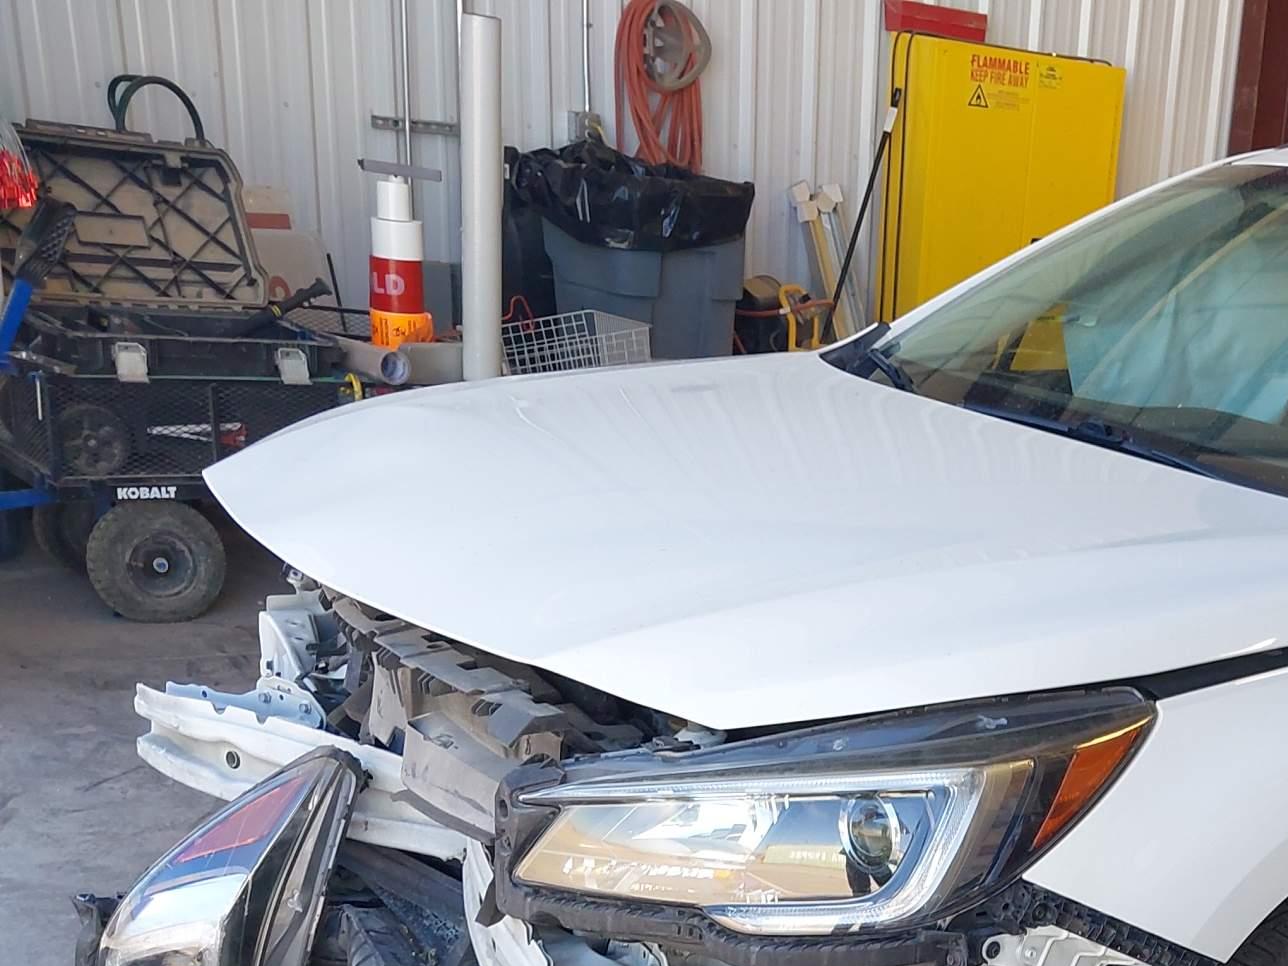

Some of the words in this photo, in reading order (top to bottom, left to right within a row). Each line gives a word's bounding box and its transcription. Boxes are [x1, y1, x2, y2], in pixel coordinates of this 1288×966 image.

[971, 54, 1030, 75] FLAMMABLE
[970, 70, 988, 82] KEEP
[990, 71, 1006, 86] FIRE
[1008, 73, 1030, 88] AWAY
[116, 486, 177, 500] KOBALT
